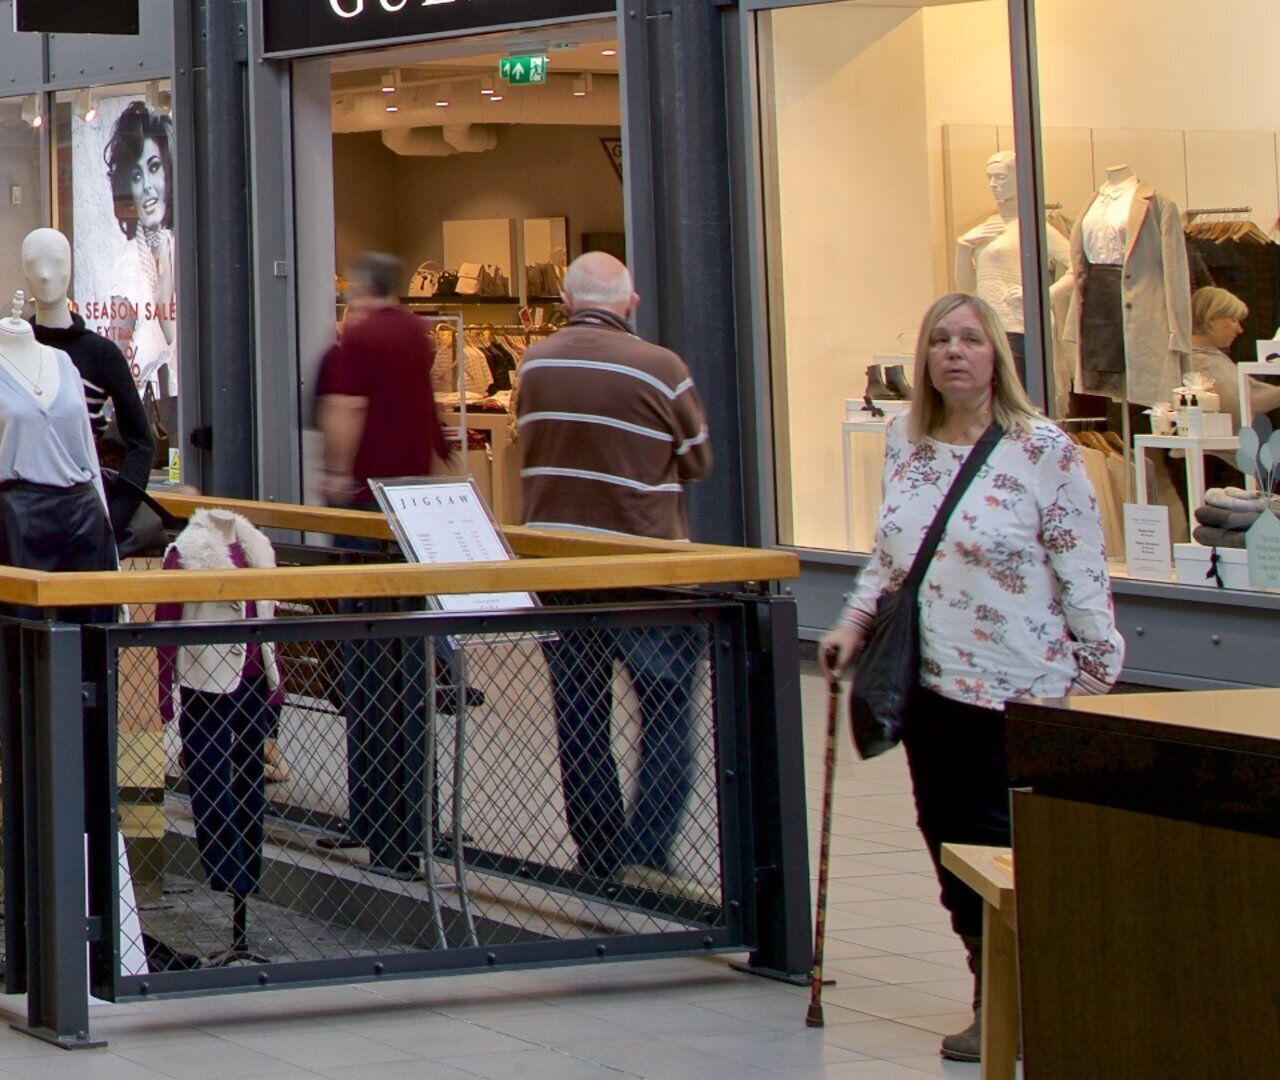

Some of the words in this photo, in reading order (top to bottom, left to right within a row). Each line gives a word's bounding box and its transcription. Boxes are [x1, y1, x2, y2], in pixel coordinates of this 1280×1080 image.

[85, 302, 139, 320] SEASON
[145, 302, 176, 320] SALE
[400, 494, 469, 510] JIGSAW
